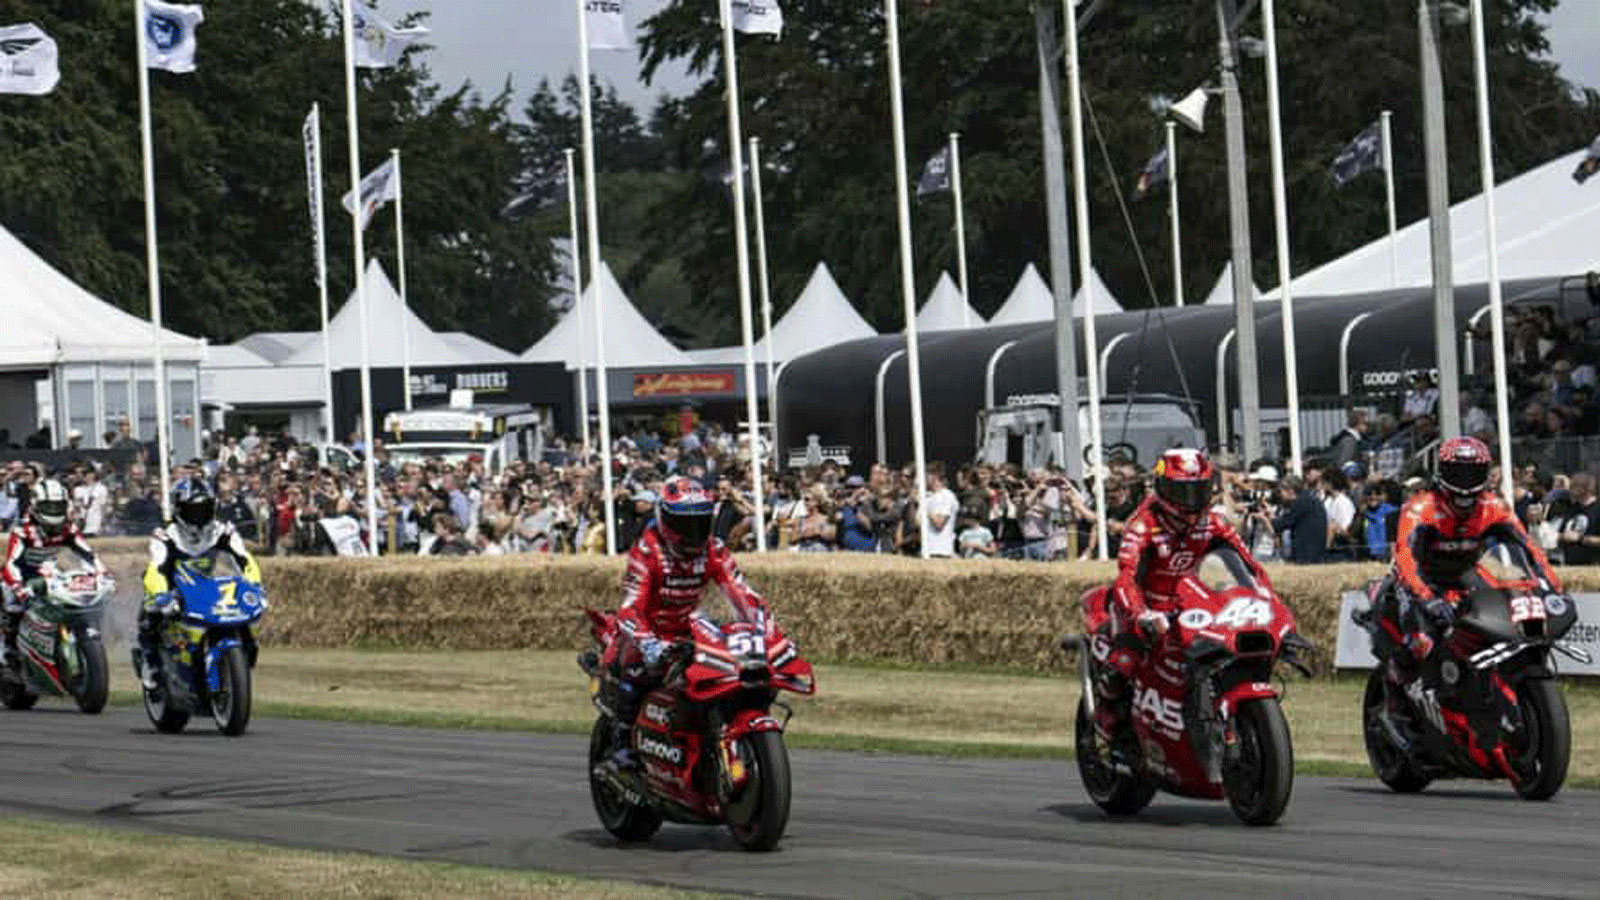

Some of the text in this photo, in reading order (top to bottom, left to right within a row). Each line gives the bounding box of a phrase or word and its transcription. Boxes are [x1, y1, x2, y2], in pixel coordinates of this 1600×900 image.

[217, 581, 238, 605] 1
[1215, 597, 1271, 627] 44
[727, 631, 765, 656] 51
[637, 729, 681, 763] Lenovo
